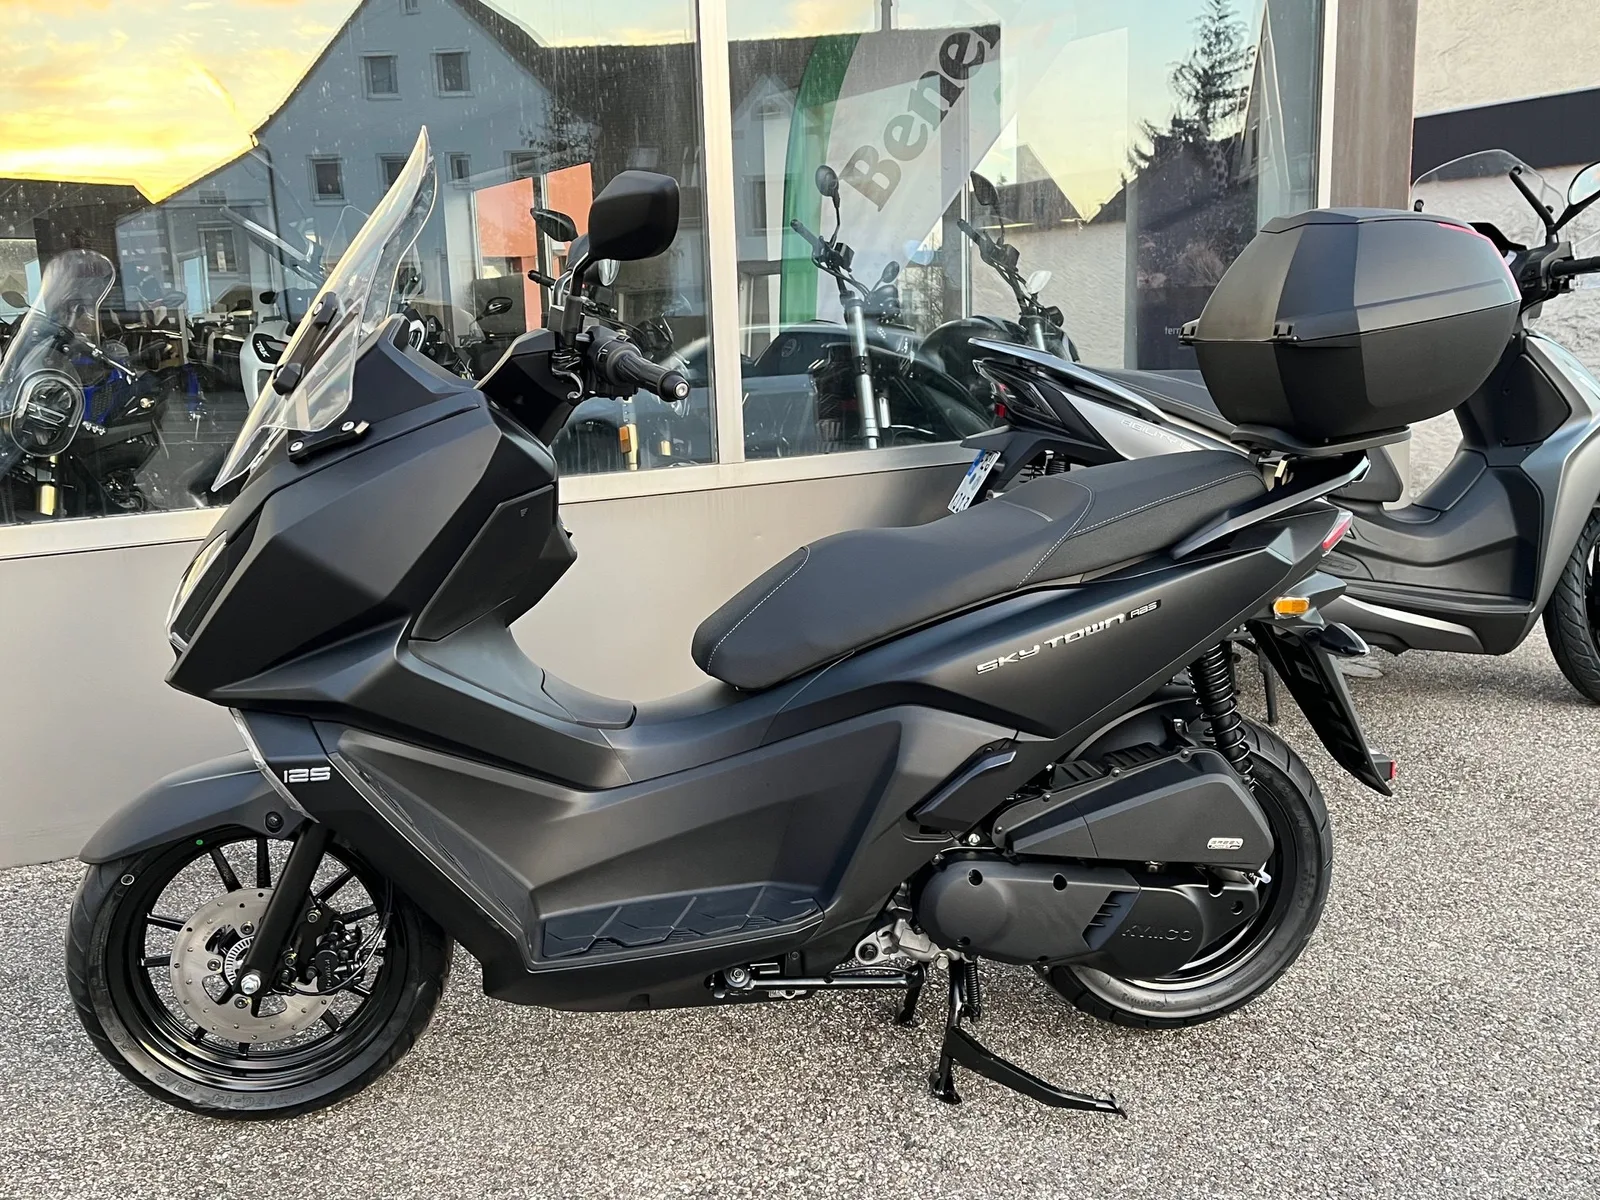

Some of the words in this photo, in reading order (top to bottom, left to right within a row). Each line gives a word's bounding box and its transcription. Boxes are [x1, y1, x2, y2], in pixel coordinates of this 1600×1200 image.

[256, 340, 270, 358] TRK
[976, 644, 1041, 675] SKY
[1043, 612, 1126, 649] TOWN
[1130, 601, 1158, 619] ABS
[283, 766, 331, 784] 125
